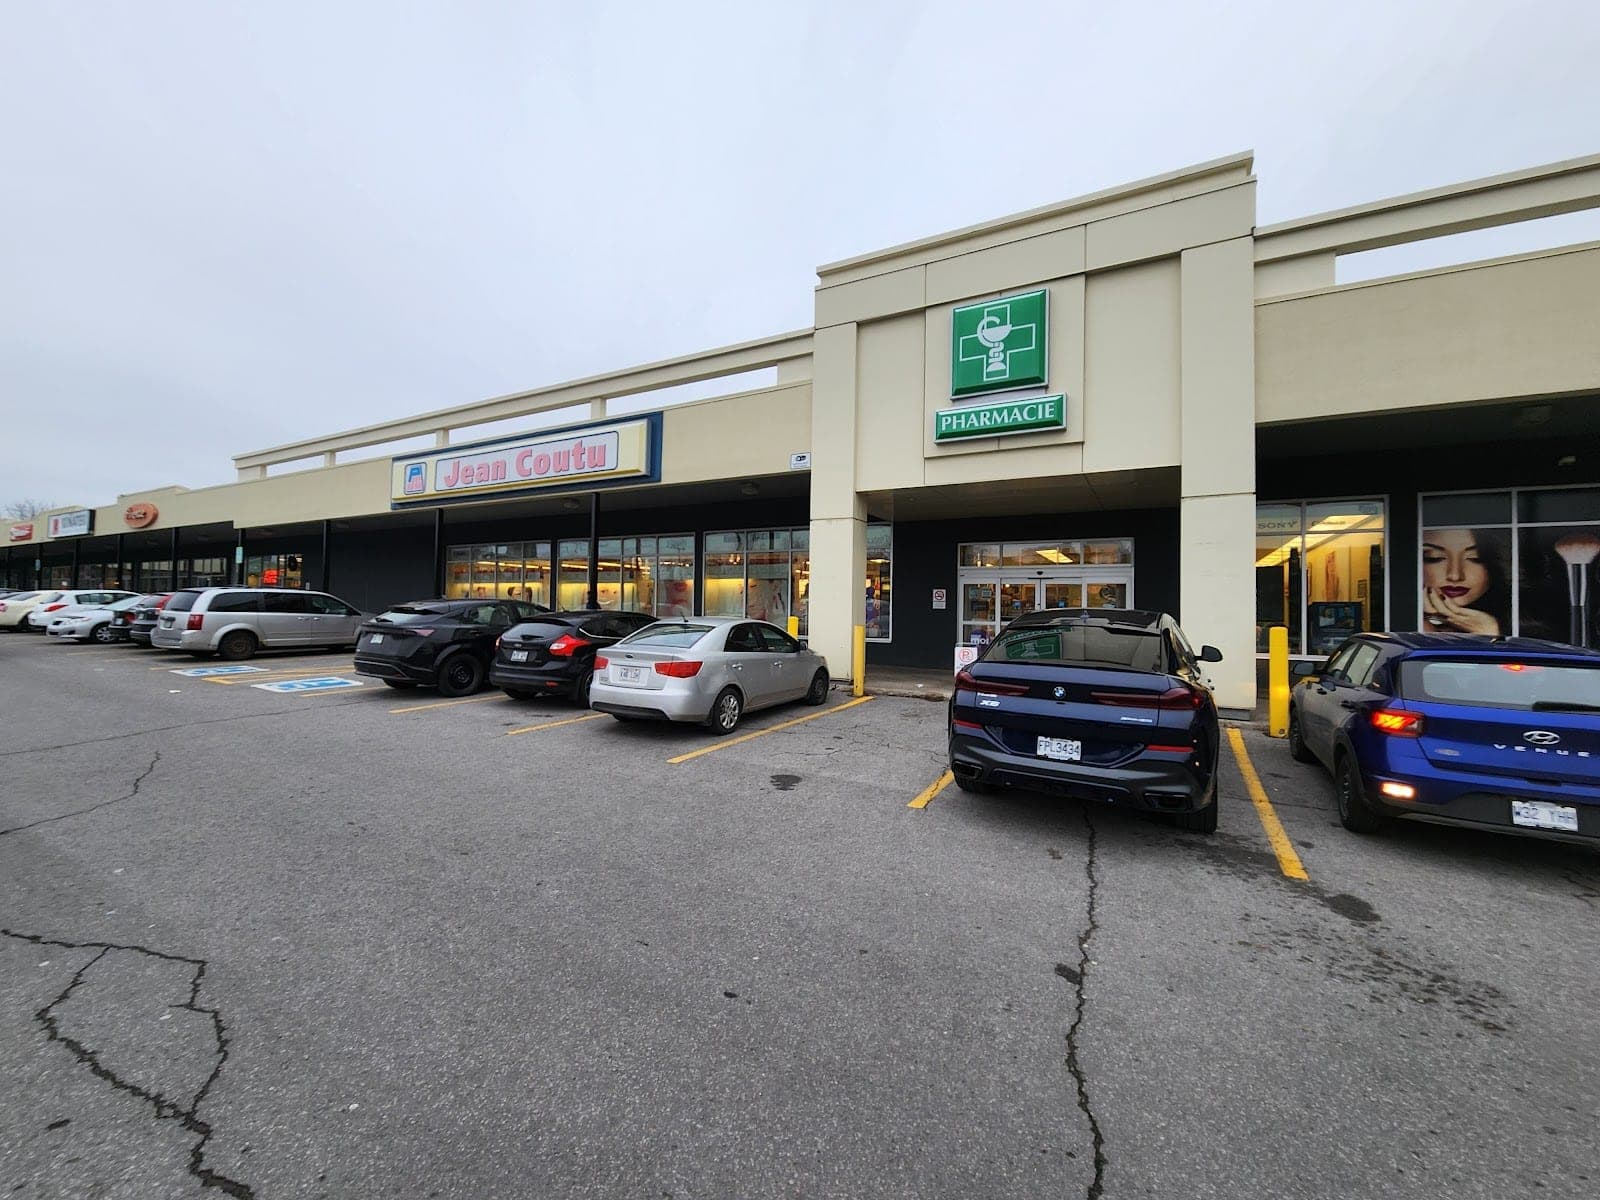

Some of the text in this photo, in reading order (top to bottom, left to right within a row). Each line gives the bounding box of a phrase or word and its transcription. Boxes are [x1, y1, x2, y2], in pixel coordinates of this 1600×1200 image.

[941, 402, 1055, 431] PHARMACIE
[444, 459, 507, 488] Jean
[515, 439, 607, 477] Coutu
[1493, 743, 1591, 758] VENUE
